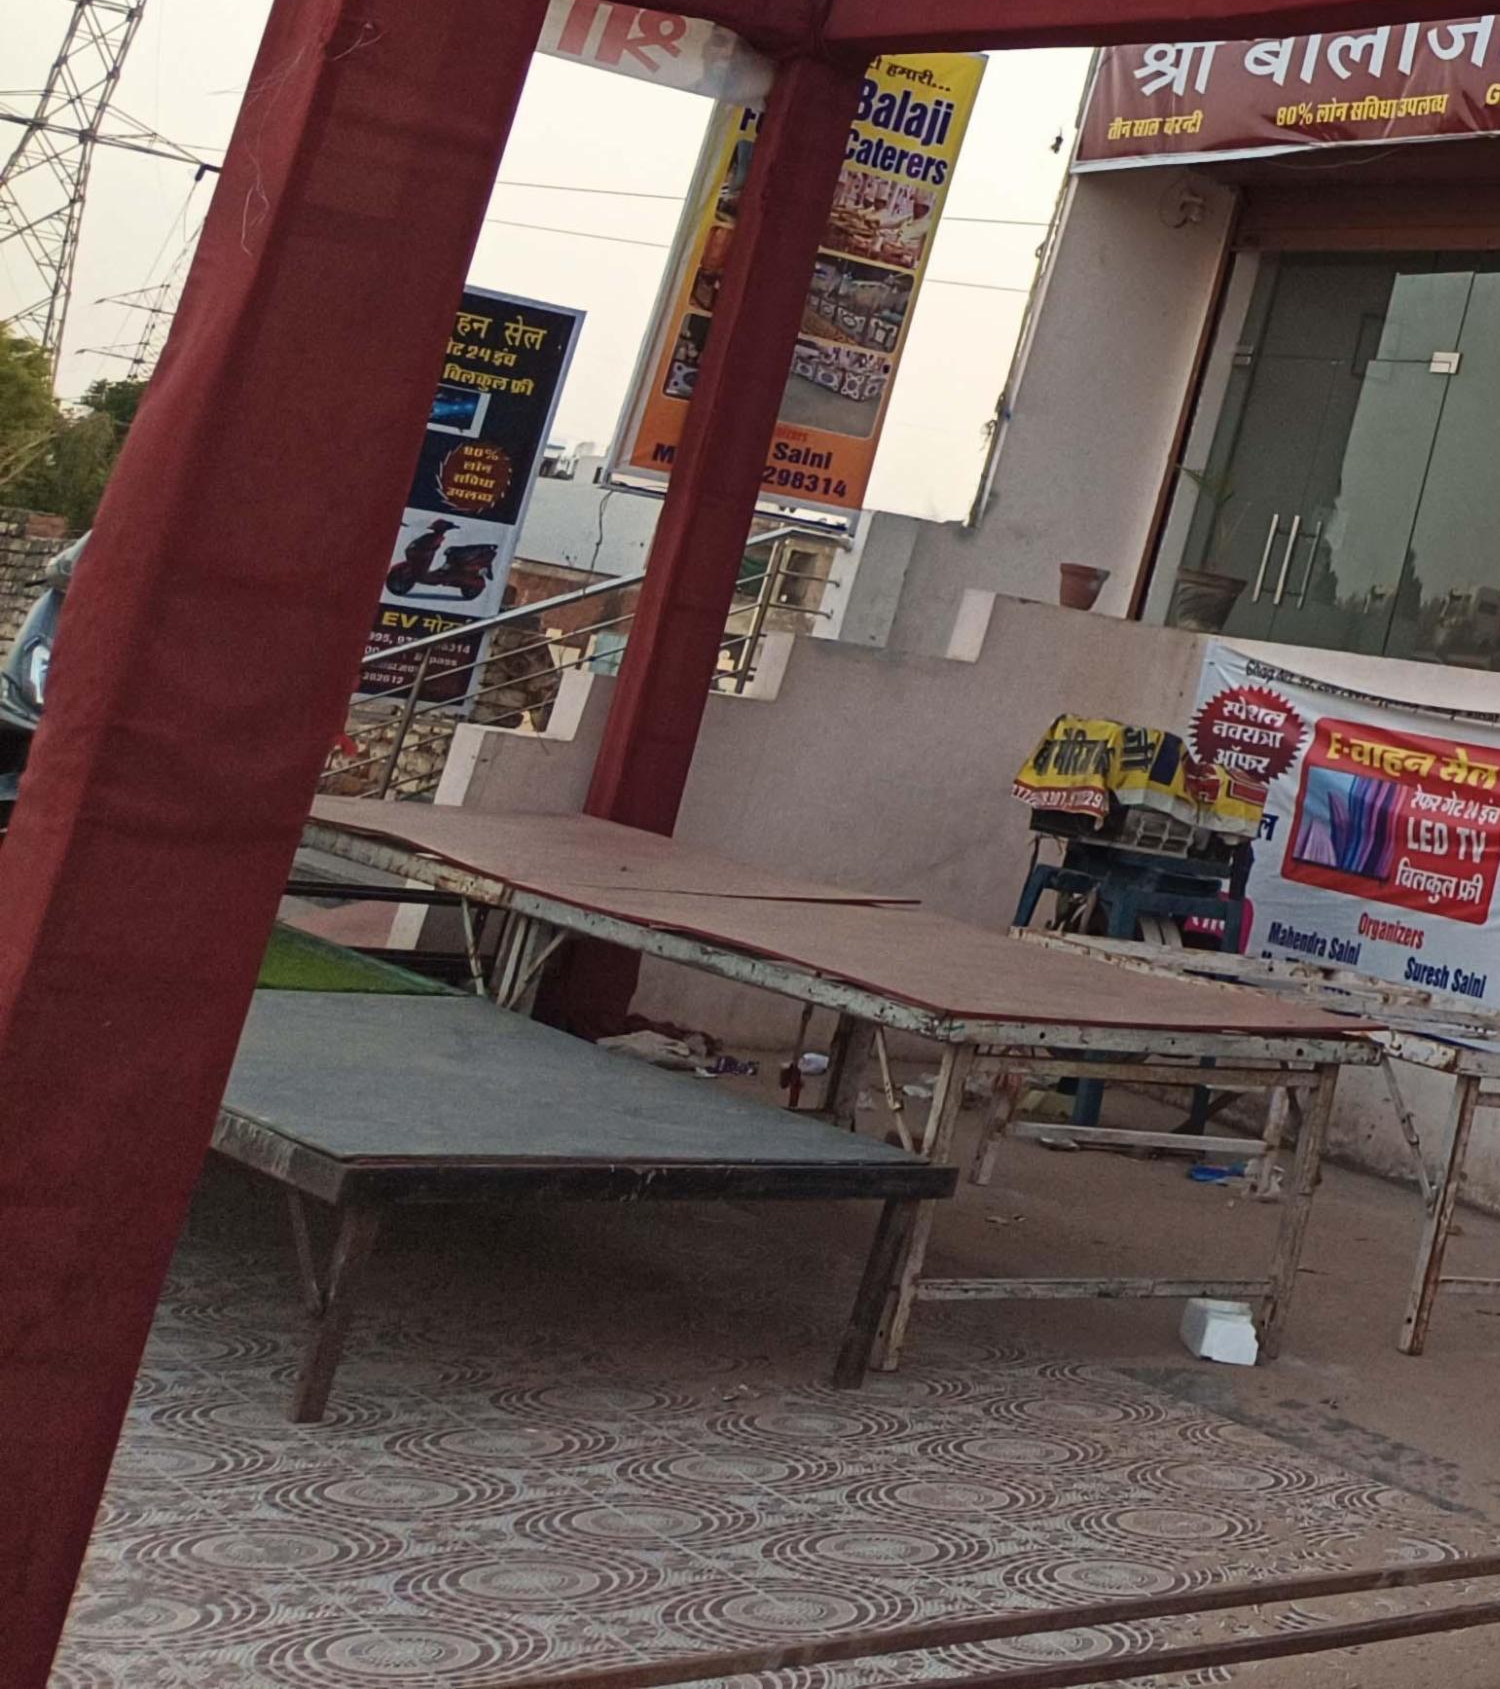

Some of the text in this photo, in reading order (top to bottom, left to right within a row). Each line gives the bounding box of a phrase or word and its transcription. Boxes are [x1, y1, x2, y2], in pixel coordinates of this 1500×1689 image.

[1275, 102, 1313, 128] 80%
[504, 315, 548, 351] सेल
[773, 441, 834, 471] Saini
[381, 611, 419, 629] EV
[1221, 695, 1287, 729] स्पेशल
[1406, 816, 1488, 864] LED TV
[1267, 921, 1328, 960] Mahendra
[1327, 936, 1362, 967] Saini
[1357, 912, 1425, 951] Organizers
[1403, 955, 1489, 1000] Suresh Saini
